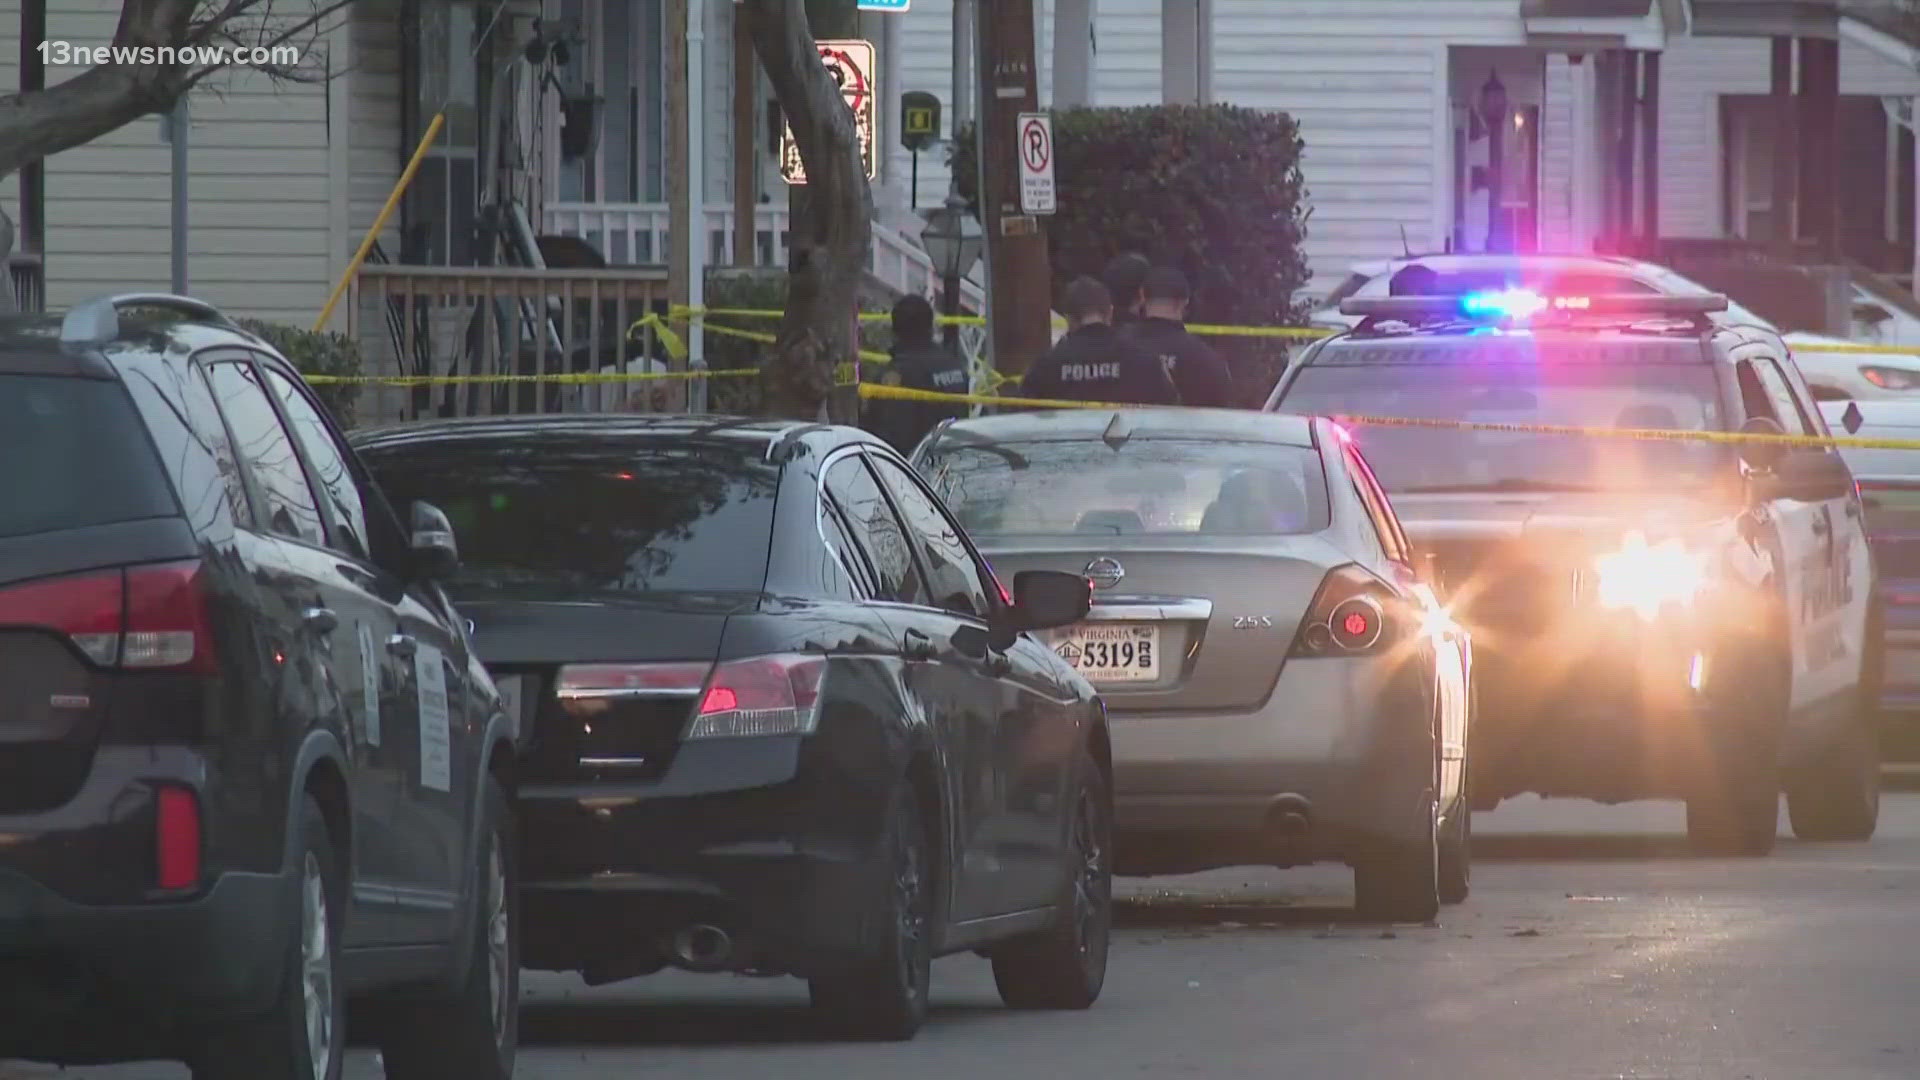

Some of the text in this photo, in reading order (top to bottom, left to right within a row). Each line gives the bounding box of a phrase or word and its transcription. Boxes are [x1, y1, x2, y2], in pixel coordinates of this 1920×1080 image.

[1061, 362, 1120, 381] POLICE
[1079, 629, 1131, 640] VIRGINIA
[1083, 641, 1134, 668] 5319
